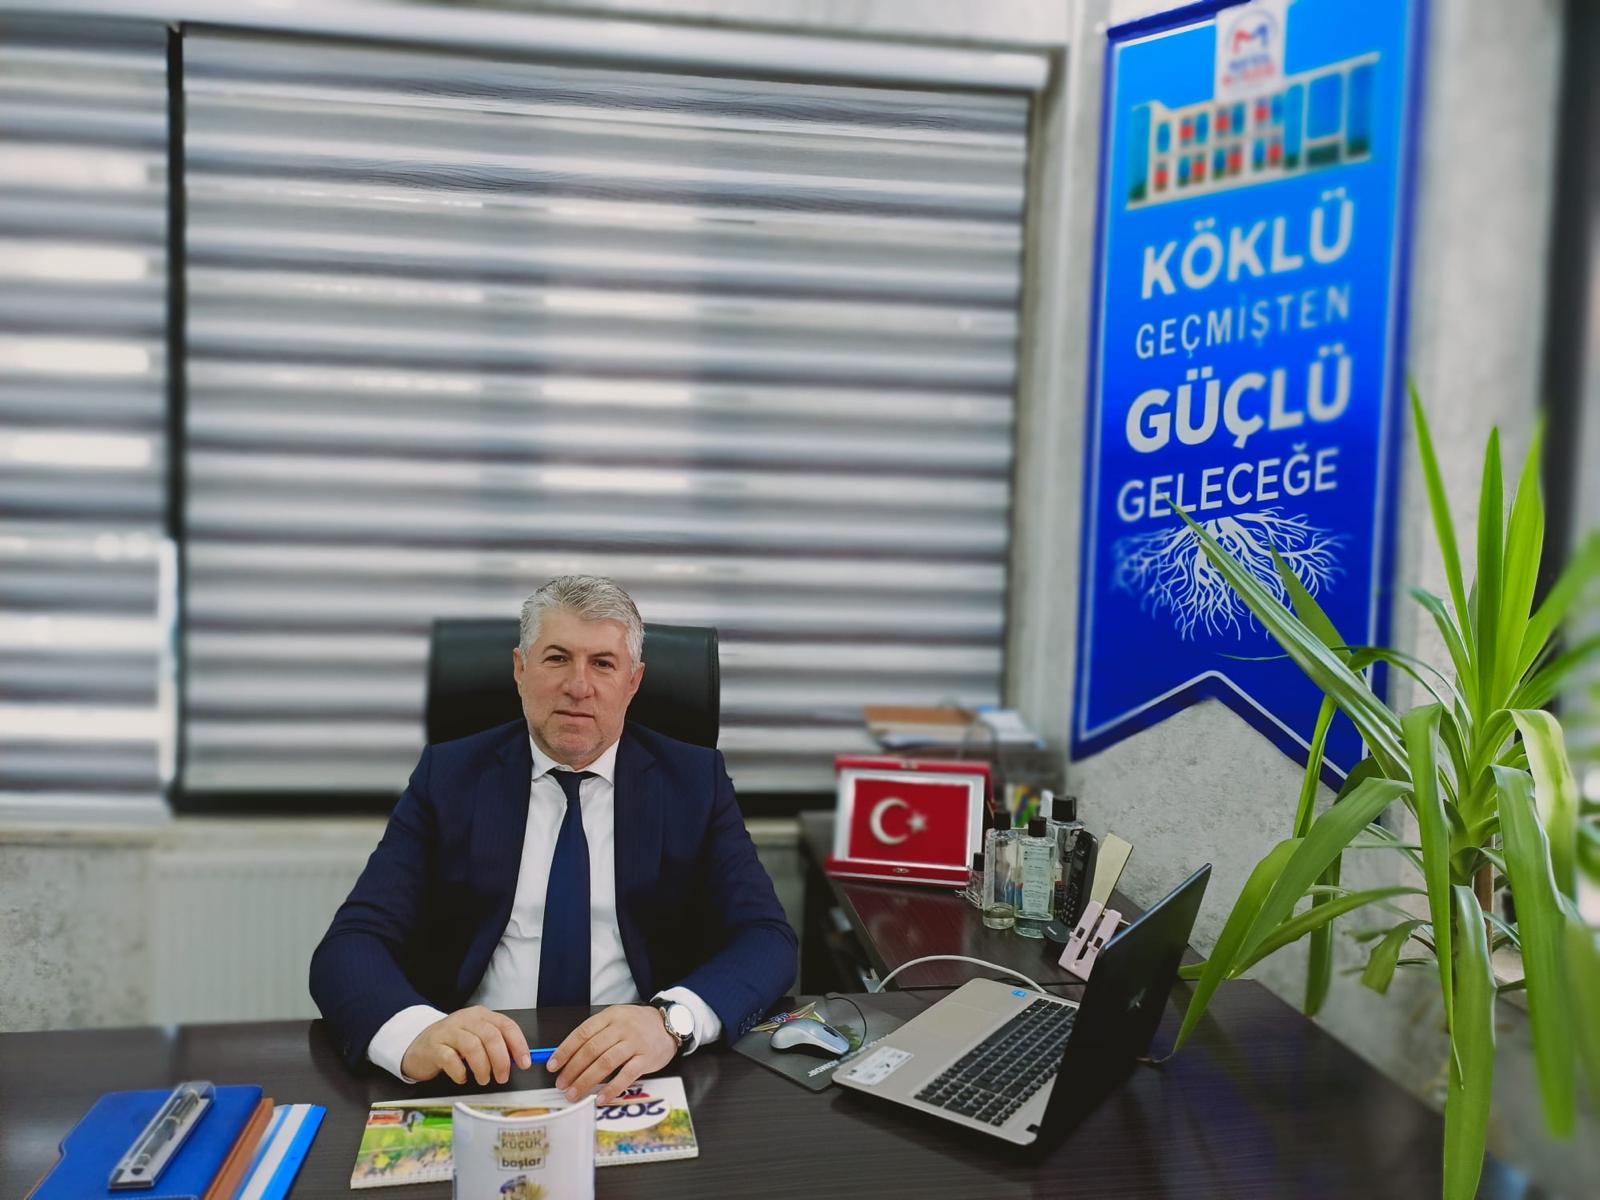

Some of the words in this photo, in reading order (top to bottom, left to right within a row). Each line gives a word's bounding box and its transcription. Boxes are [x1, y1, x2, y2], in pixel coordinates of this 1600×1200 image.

[1141, 187, 1354, 300] KÖKLÜ
[1135, 284, 1350, 360] GEÇMİŞTEN
[1125, 342, 1352, 454] GÜÇLÜ
[1117, 442, 1340, 523] GELECEĞE
[502, 1157, 542, 1170] başlar
